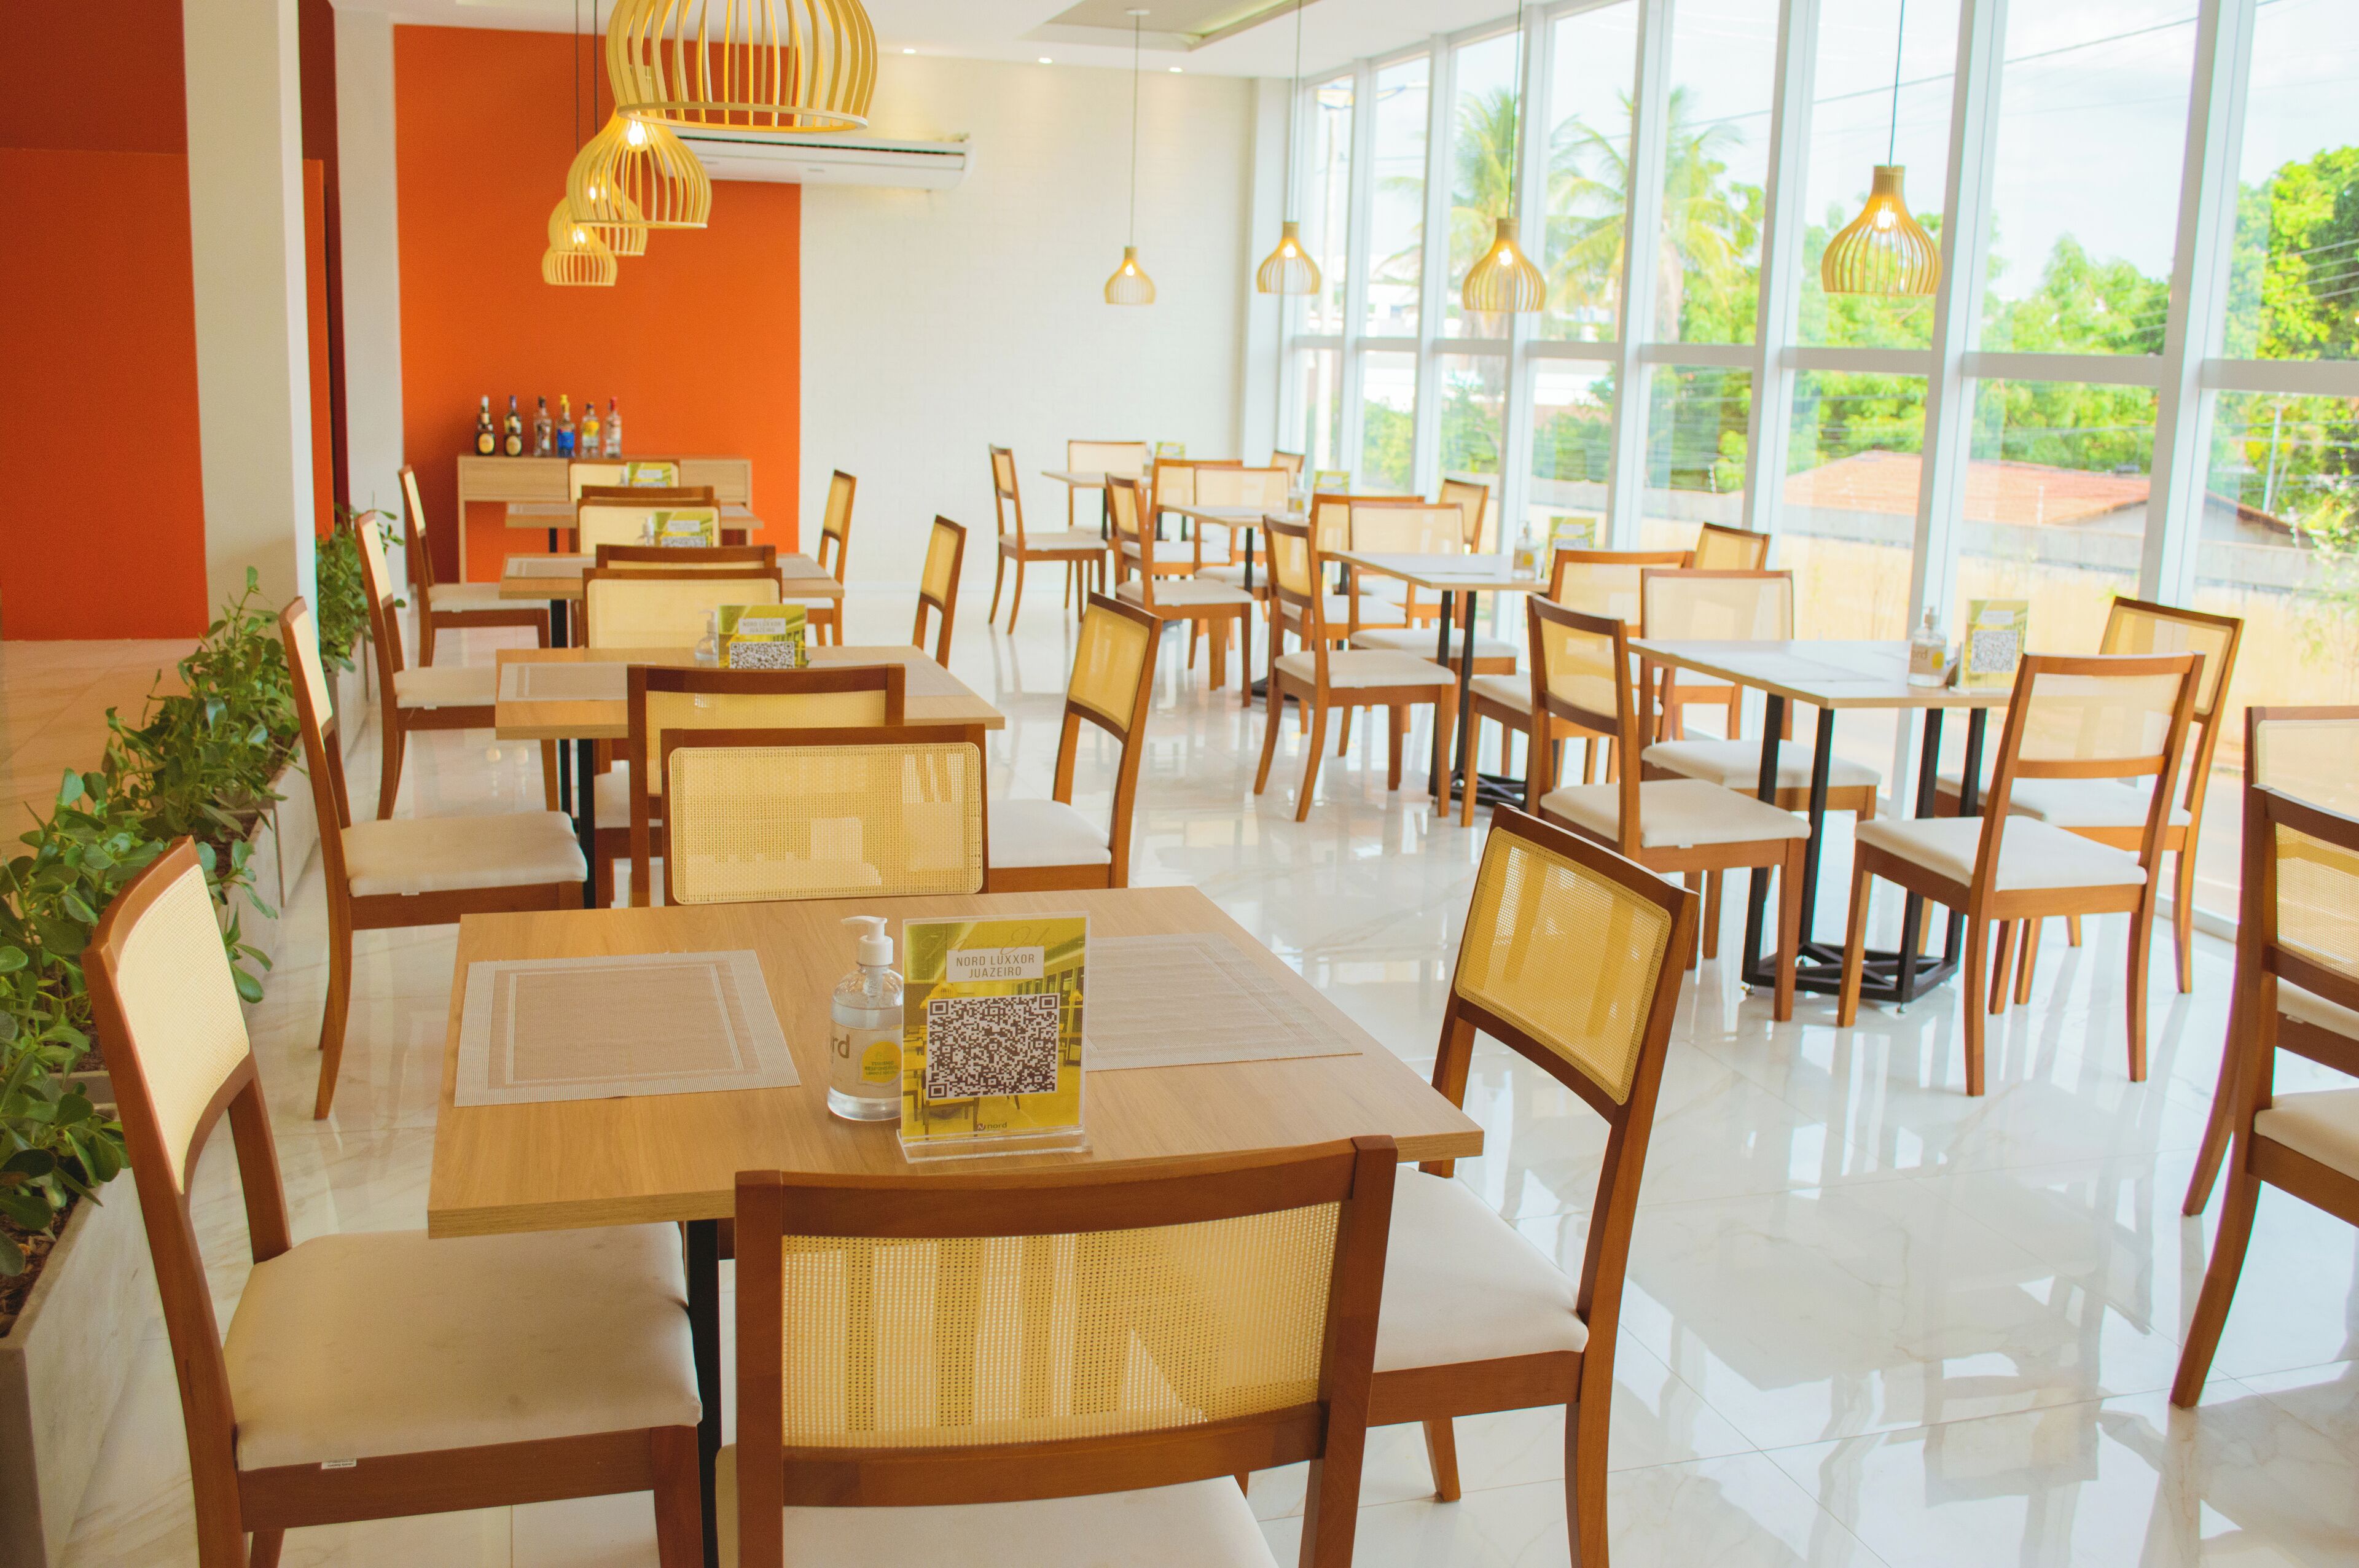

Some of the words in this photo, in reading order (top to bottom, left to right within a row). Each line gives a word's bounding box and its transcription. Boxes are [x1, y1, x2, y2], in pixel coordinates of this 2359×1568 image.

[957, 956, 986, 967] NORD
[991, 954, 1035, 964] LUXXOR
[969, 967, 1022, 978] JUAZEIRO
